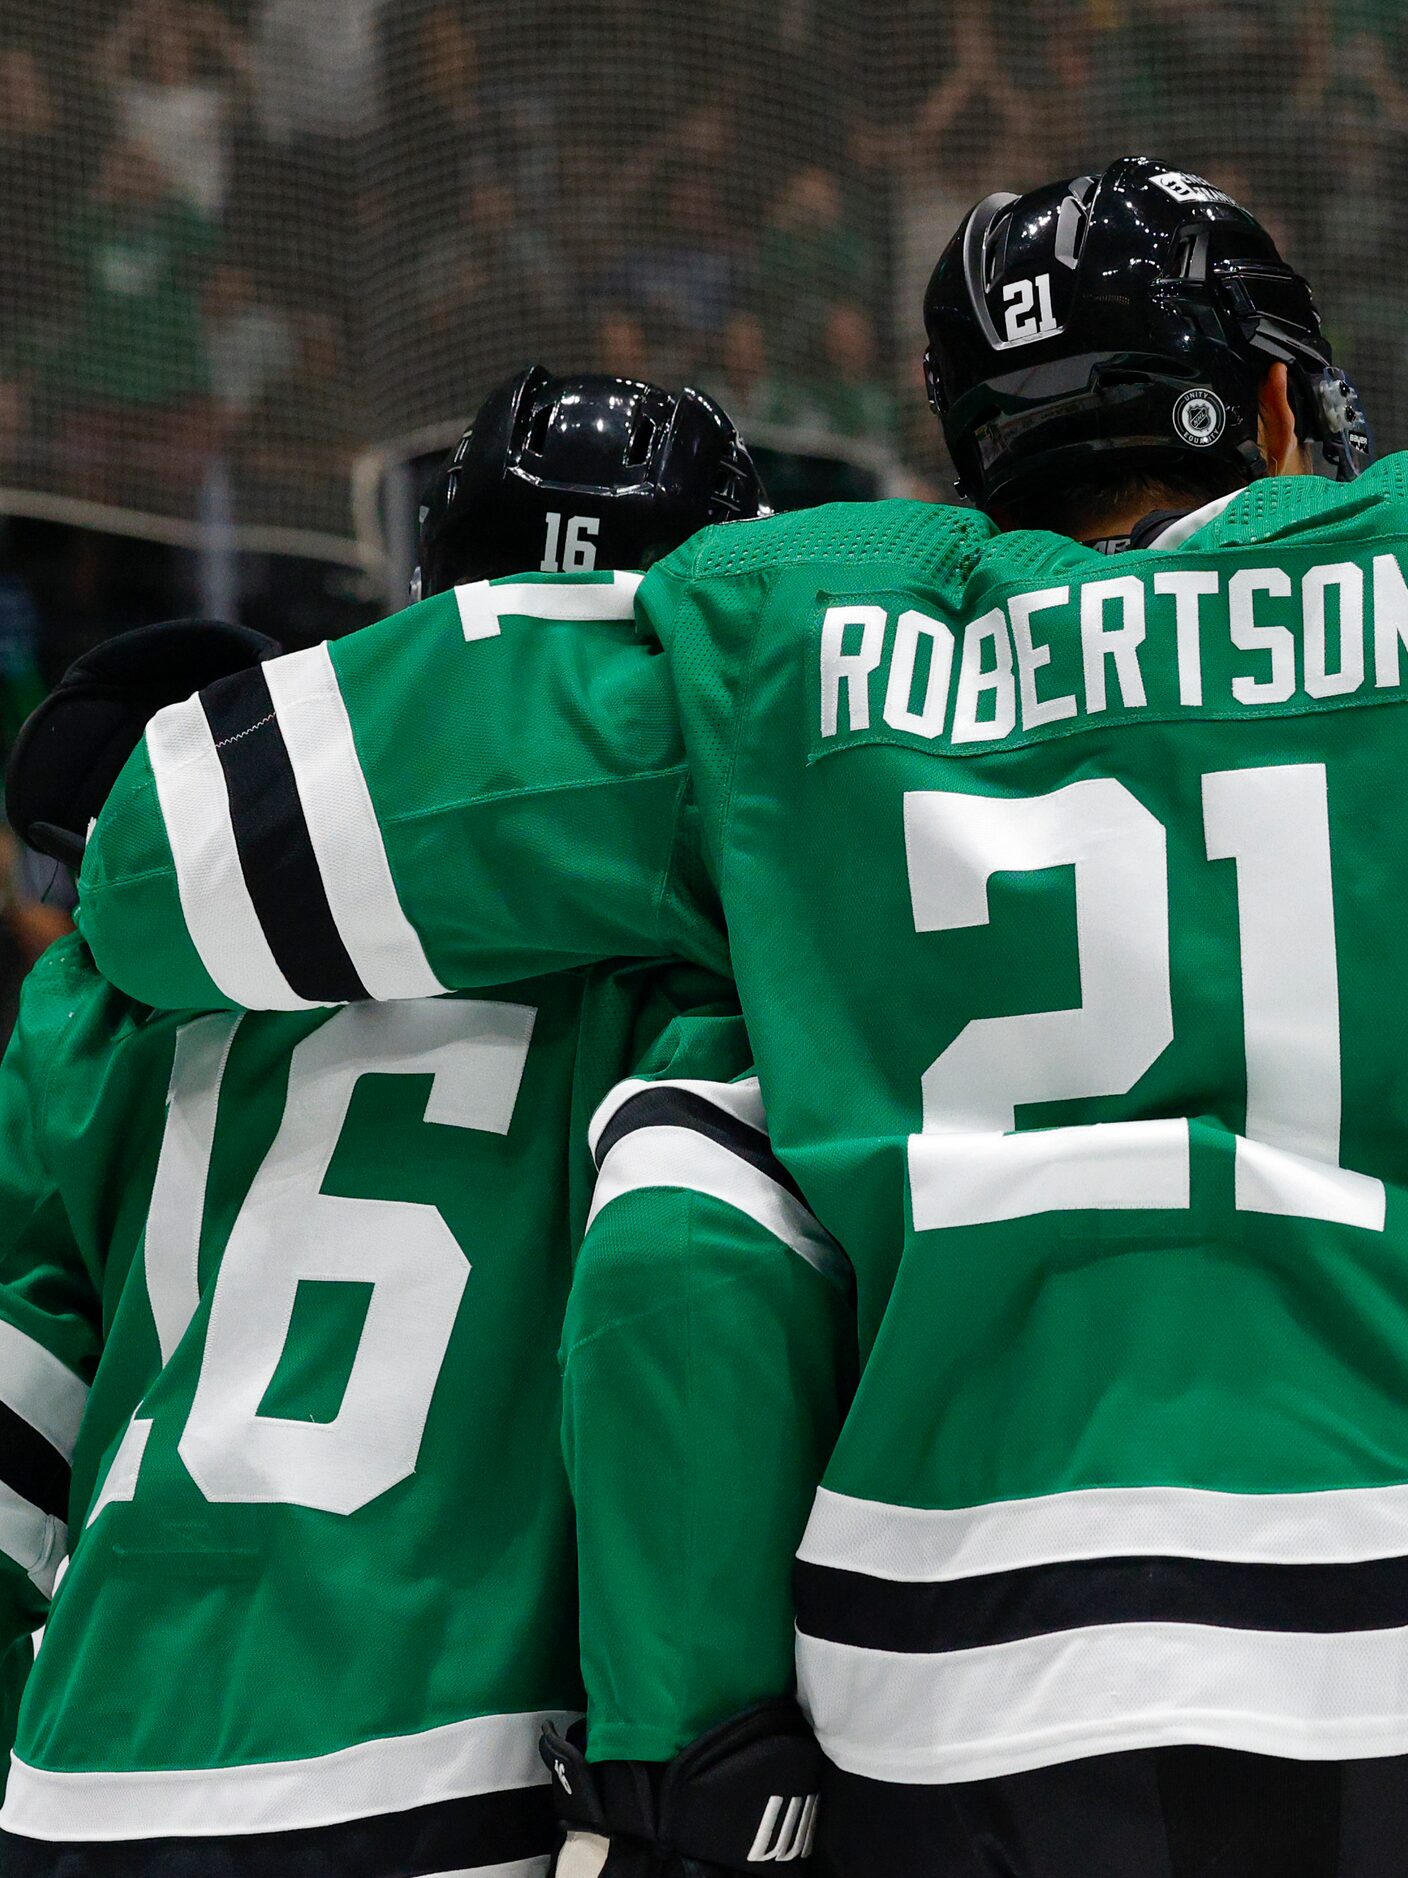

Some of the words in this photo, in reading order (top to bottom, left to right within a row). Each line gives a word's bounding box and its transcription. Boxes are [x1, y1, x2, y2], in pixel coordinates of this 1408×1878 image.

[1002, 273, 1057, 342] 21
[1184, 391, 1209, 402] UNITY
[1183, 428, 1219, 444] EQUAITY
[540, 511, 600, 574] 16
[903, 763, 1386, 1232] 21
[86, 998, 537, 1528] 16
